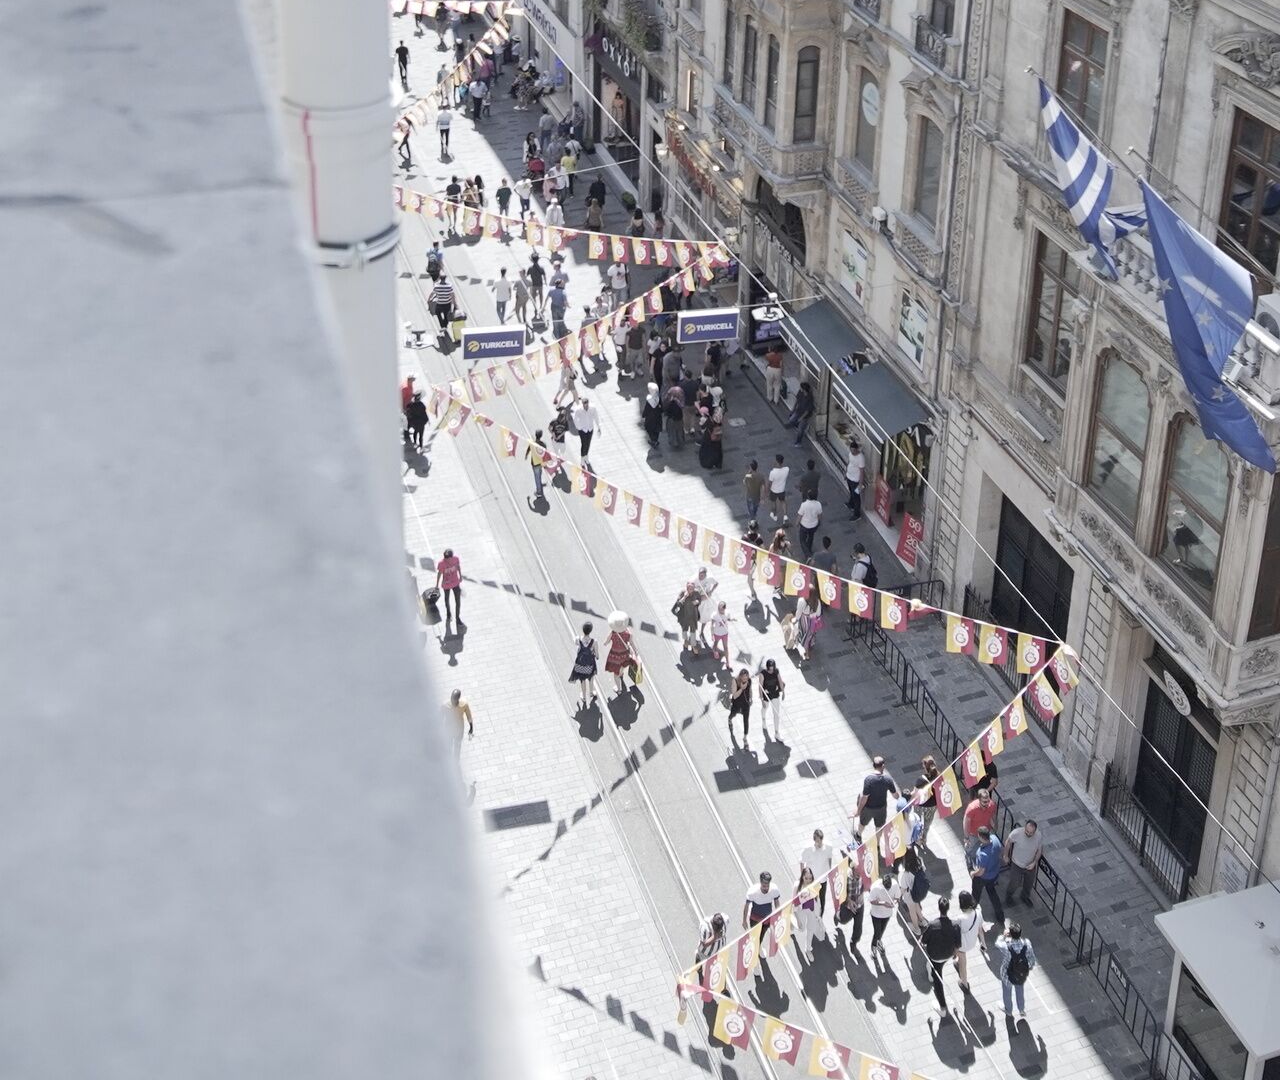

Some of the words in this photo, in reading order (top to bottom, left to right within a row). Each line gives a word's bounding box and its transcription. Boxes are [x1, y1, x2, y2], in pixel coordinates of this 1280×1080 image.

[602, 37, 630, 77] OXXO
[695, 322, 735, 332] TURKCELL
[480, 340, 520, 349] TURKCELL
